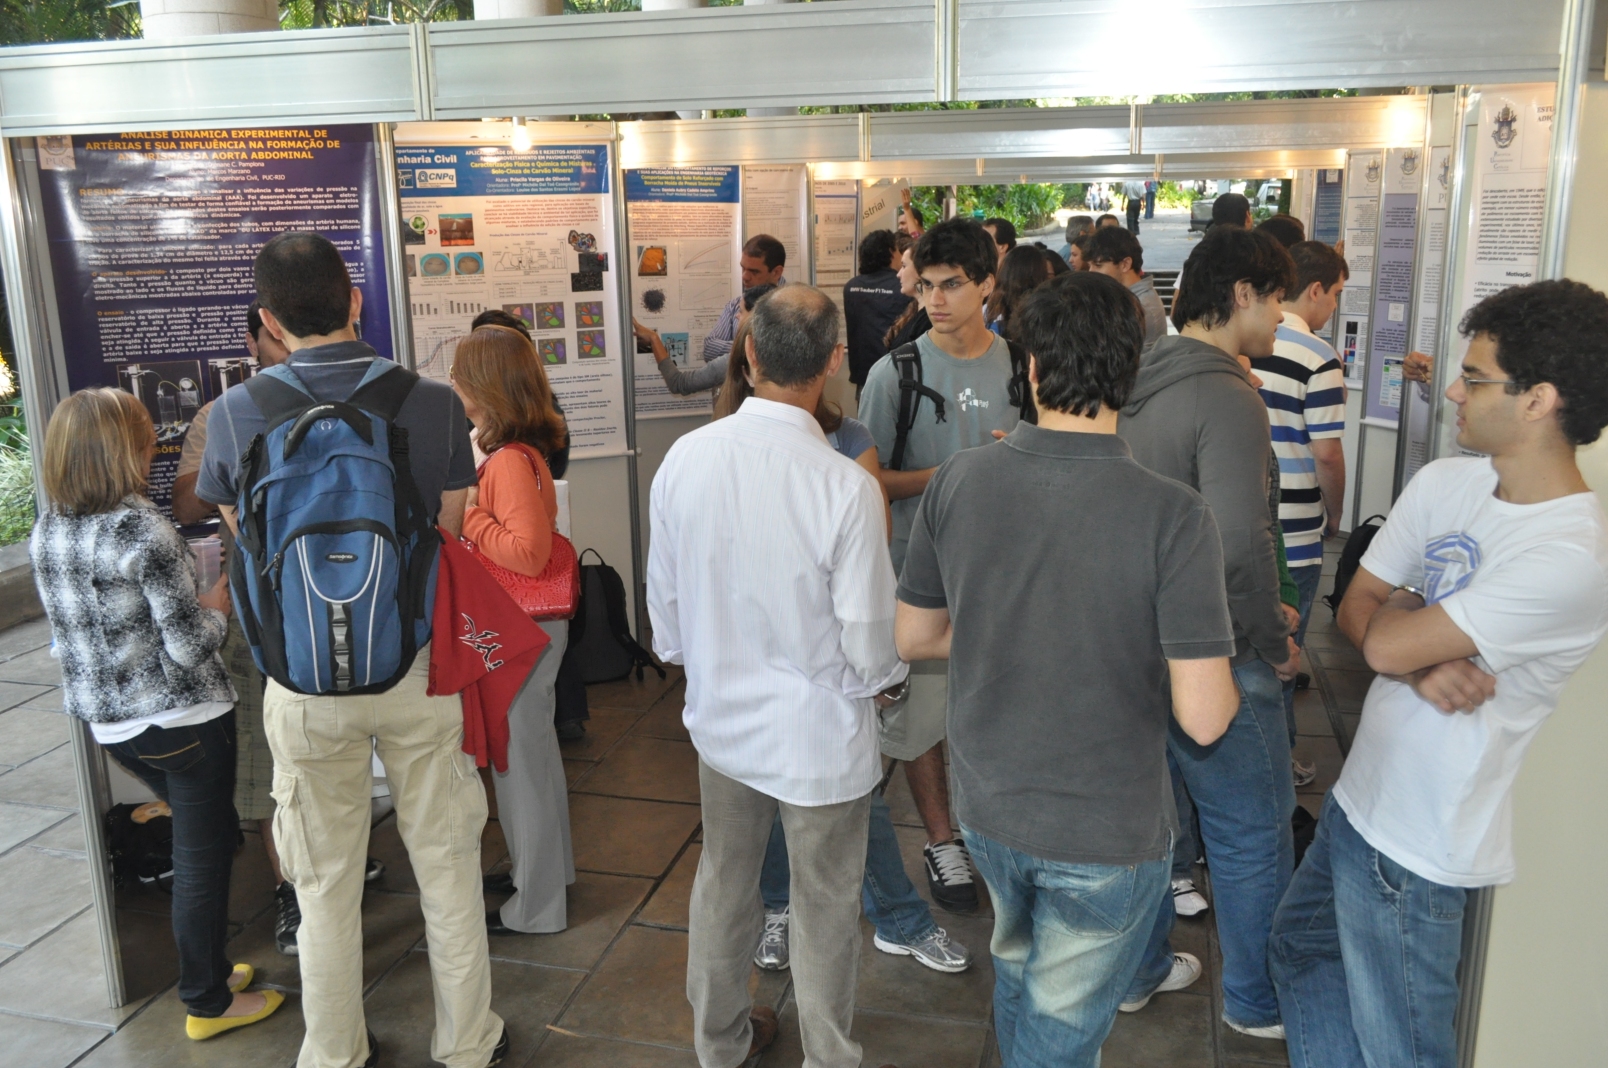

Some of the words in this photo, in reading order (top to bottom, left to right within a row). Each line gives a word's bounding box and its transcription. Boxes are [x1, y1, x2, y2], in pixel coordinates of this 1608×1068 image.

[86, 140, 142, 150] ARTÉRIAS
[180, 139, 245, 149] INFLUÊNCIA
[267, 140, 324, 149] FORMAÇÃO
[398, 155, 431, 164] nharia
[434, 155, 457, 163] Civil
[429, 173, 454, 181] CNPq
[156, 445, 181, 453] SÕES
